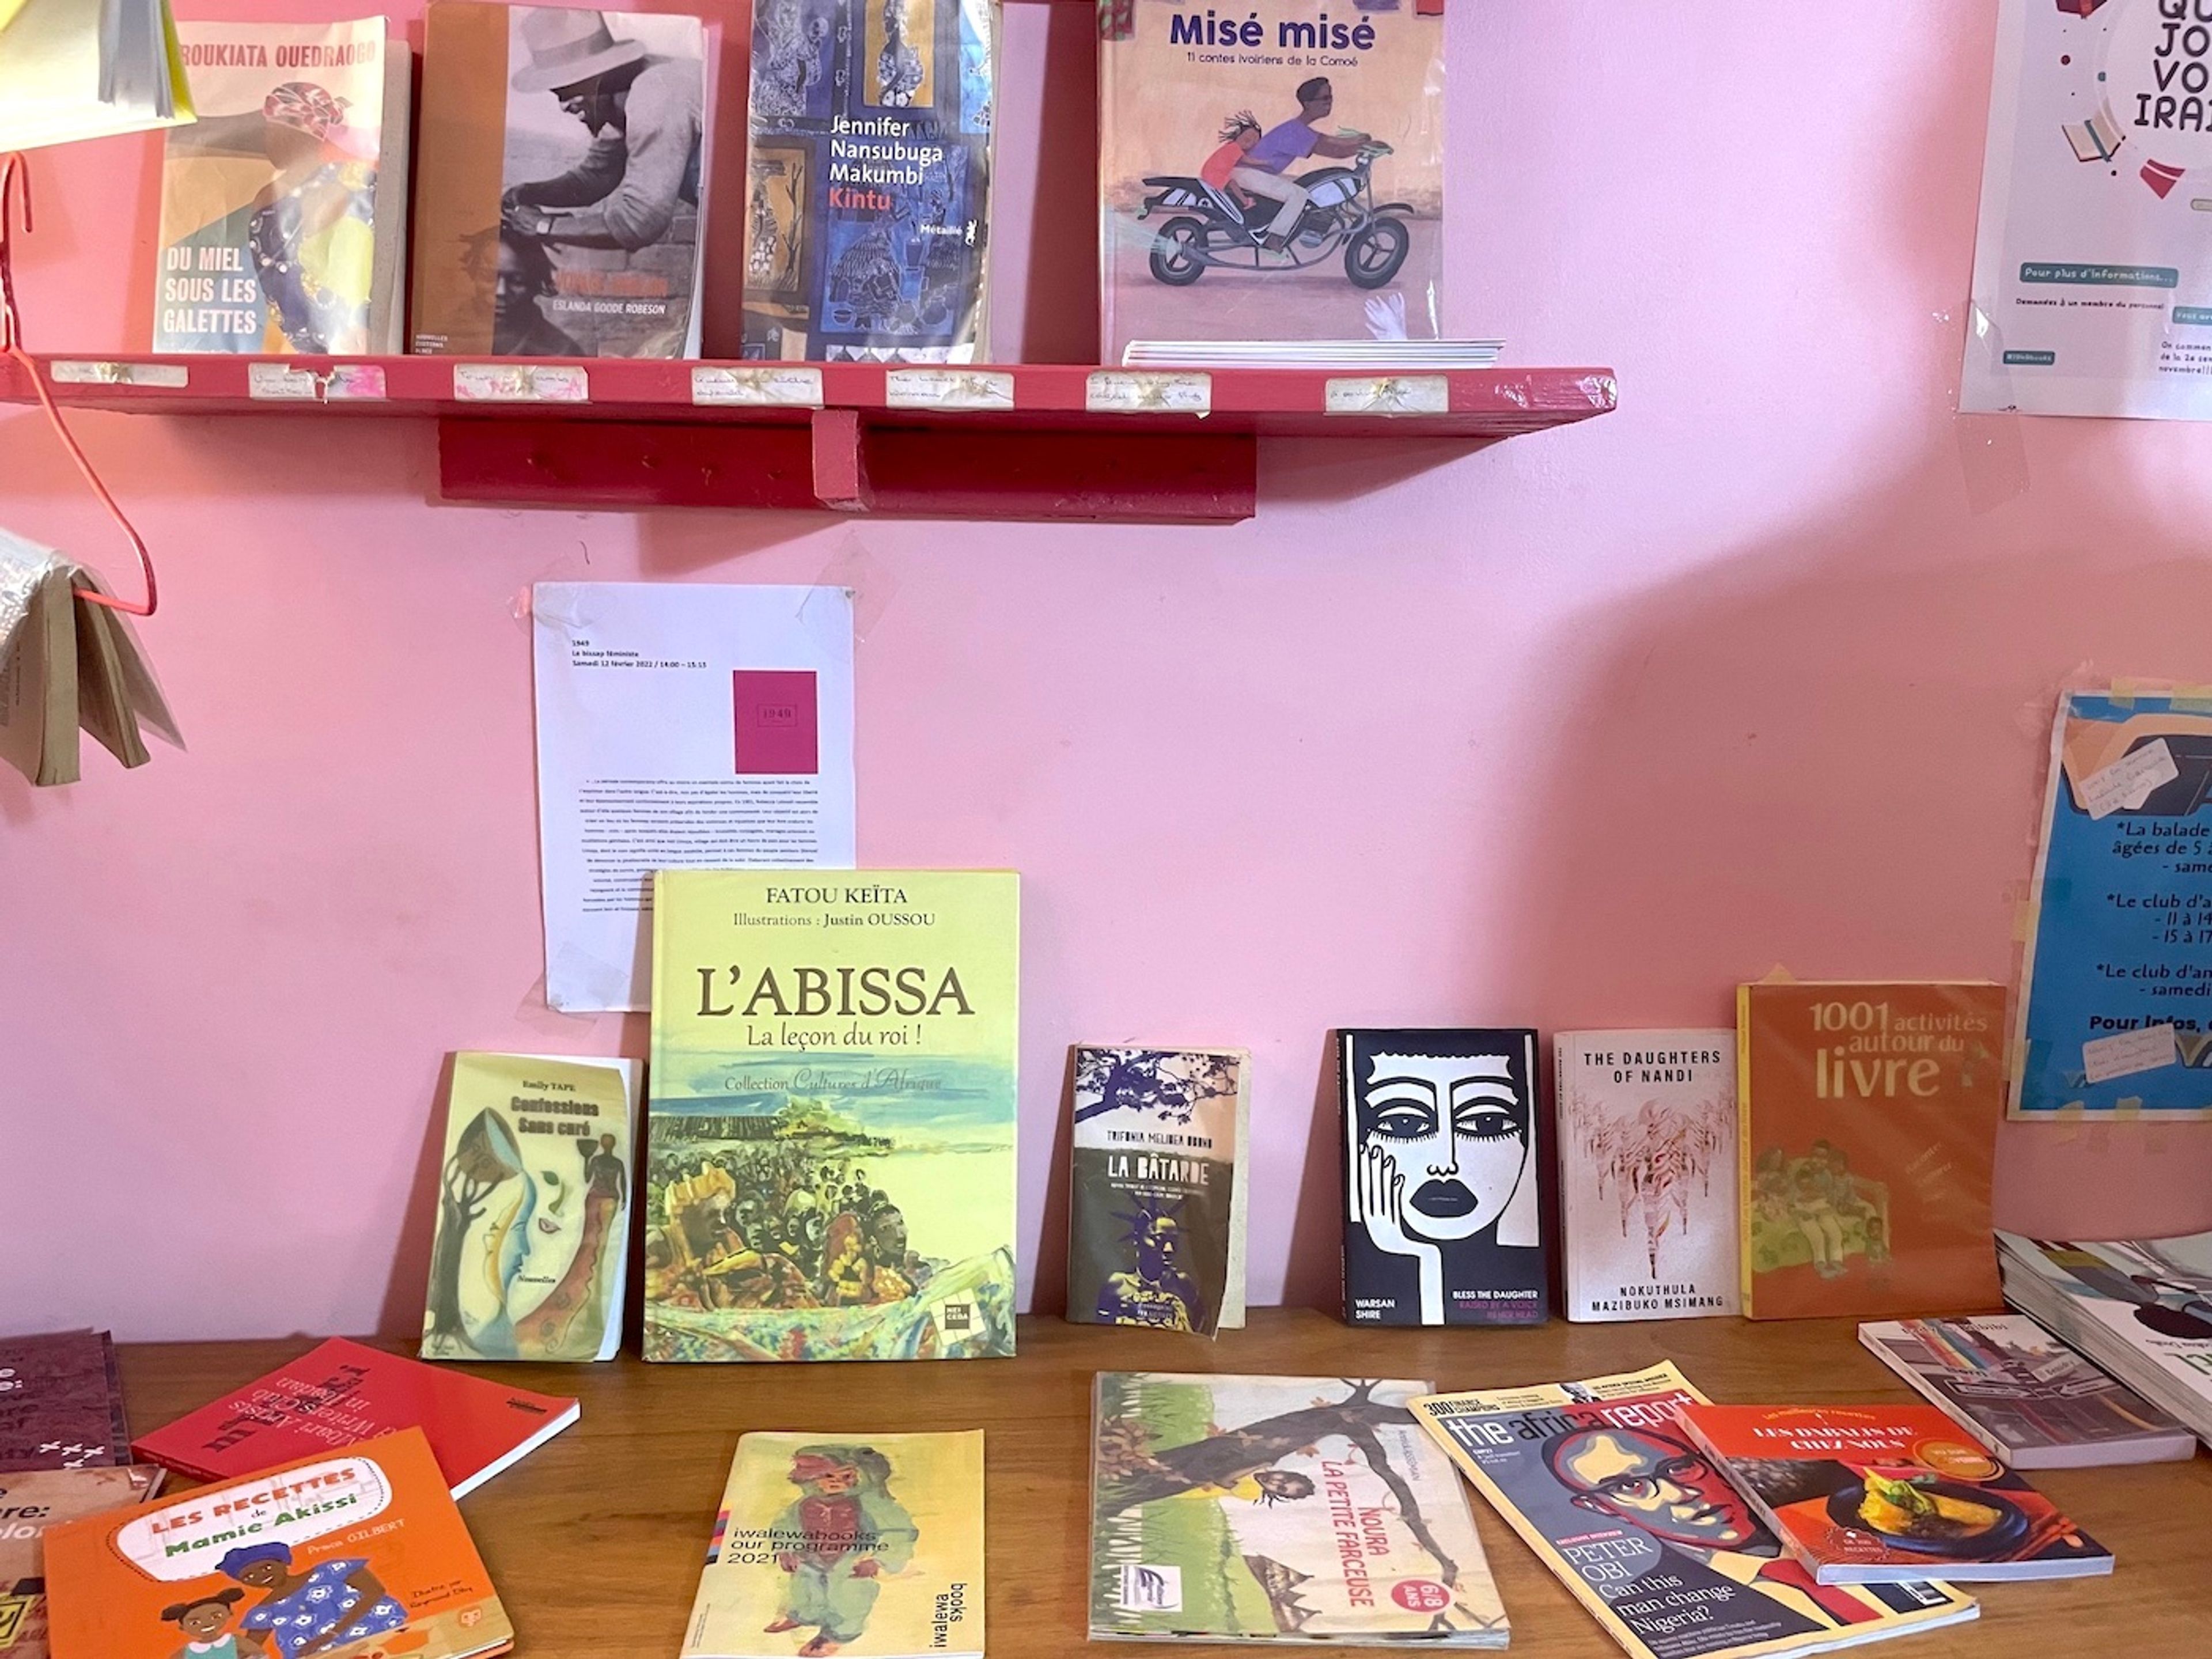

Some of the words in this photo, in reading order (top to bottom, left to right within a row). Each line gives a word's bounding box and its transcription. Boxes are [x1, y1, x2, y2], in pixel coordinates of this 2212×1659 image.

[1170, 10, 1264, 46] Misé
[1279, 14, 1376, 50] misé
[2155, 22, 2210, 56] JO
[183, 44, 267, 68] ROUKIATA
[276, 41, 376, 67] OUEDRAOGO
[1187, 52, 1195, 62] 11
[1199, 53, 1235, 63] contes
[1238, 54, 1283, 65] ivoiriens
[1287, 55, 1301, 66] de
[1305, 55, 1317, 66] la
[1320, 55, 1358, 67] Comoé
[2153, 59, 2209, 93] VO
[2134, 93, 2212, 132] IRA
[830, 115, 911, 138] Jennifer
[830, 139, 944, 164] Nansubuga
[830, 163, 924, 185] Makumbi
[830, 187, 891, 211] Kintu
[167, 247, 191, 271] DU
[199, 247, 243, 271] MIEL
[2025, 268, 2051, 277] Pour
[2055, 270, 2076, 279] plus
[165, 278, 214, 302] SOUS
[222, 279, 257, 303] LES
[553, 300, 592, 312] ESLANDA
[594, 302, 623, 313] GOODE
[626, 304, 667, 315] ROBESON
[2081, 300, 2113, 308] membre
[164, 310, 257, 333] GALETTES
[763, 709, 791, 718] 1949
[2152, 822, 2211, 836] balade
[2112, 840, 2160, 858] âgées
[2166, 840, 2187, 854] de
[2194, 840, 2202, 855] 5
[766, 888, 839, 904] FATOU
[844, 885, 908, 904] KEÏTA
[2142, 894, 2180, 908] club
[733, 913, 812, 927] Illustrations
[823, 913, 863, 929] Justin
[868, 913, 936, 927] OUSSOU
[2183, 912, 2191, 926] à
[2164, 929, 2177, 944] 15
[2183, 930, 2192, 943] à
[2132, 964, 2171, 978] club
[2150, 982, 2211, 997] samedi
[1810, 1002, 1889, 1031] 1001
[1895, 1012, 1987, 1031] activités
[2090, 1016, 2139, 1030] Pour
[748, 1025, 773, 1046] La
[781, 1021, 836, 1052] leçon
[843, 1021, 873, 1046] du
[879, 1025, 910, 1046] roi
[915, 1025, 922, 1046] !
[1849, 1031, 1933, 1052] autour
[1939, 1035, 1964, 1052] du
[1584, 1052, 1615, 1066] THE
[1623, 1051, 1721, 1065] DAUGHTERS
[725, 1076, 789, 1092] Collection
[792, 1067, 858, 1093] Cultures
[1615, 1069, 1634, 1084] OF
[1642, 1068, 1693, 1082] NANDI
[1817, 1046, 1941, 1098] livre
[523, 1081, 548, 1090] Emily
[512, 1096, 599, 1116] Confessions
[518, 1117, 554, 1134] Sans
[558, 1120, 590, 1137] curé
[1107, 1130, 1145, 1142] TRIFONIA
[1108, 1155, 1129, 1177] LA
[1137, 1153, 1209, 1185] BÂTARDE
[1453, 1291, 1476, 1300] BLESS
[1478, 1291, 1492, 1299] THE
[1493, 1290, 1538, 1299] DAUGHTER
[1620, 1285, 1696, 1297] NOKUTHULA
[1355, 1299, 1395, 1308] WARSAN
[1592, 1297, 1659, 1312] MAZIBUKO
[1665, 1296, 1723, 1309] MSIMANG
[1355, 1310, 1381, 1319] SHIRE
[252, 1388, 300, 1411] Club
[346, 1397, 370, 1412] in
[1423, 1400, 1454, 1416] 300
[1448, 1418, 1514, 1447] the
[1509, 1410, 1603, 1440] africa
[1600, 1389, 1694, 1429] report
[1321, 1461, 1344, 1478] LA
[151, 1511, 202, 1536] LES
[211, 1467, 356, 1518] RECETTES
[1325, 1482, 1357, 1528] PETITE
[251, 1508, 267, 1519] de
[164, 1521, 263, 1558] Mamie
[272, 1494, 358, 1528] Akissi
[347, 1518, 406, 1542] GILBERT
[734, 1527, 877, 1541] iwalewabooks
[1357, 1507, 1390, 1556] NOURA
[731, 1539, 764, 1550] our
[772, 1539, 889, 1554] programme
[1563, 1537, 1654, 1565] PETER
[727, 1553, 779, 1564] 2021
[1336, 1532, 1375, 1607] FARCEUSE
[1581, 1561, 1634, 1582] OBI
[1403, 1585, 1421, 1608] ANS
[1599, 1582, 1643, 1600] Can
[1642, 1573, 1684, 1592] this
[949, 1582, 968, 1622] books
[1616, 1600, 1665, 1618] man
[1665, 1584, 1736, 1608] change
[929, 1593, 949, 1648] iwalewa
[1631, 1604, 1714, 1635] Nigeria?
